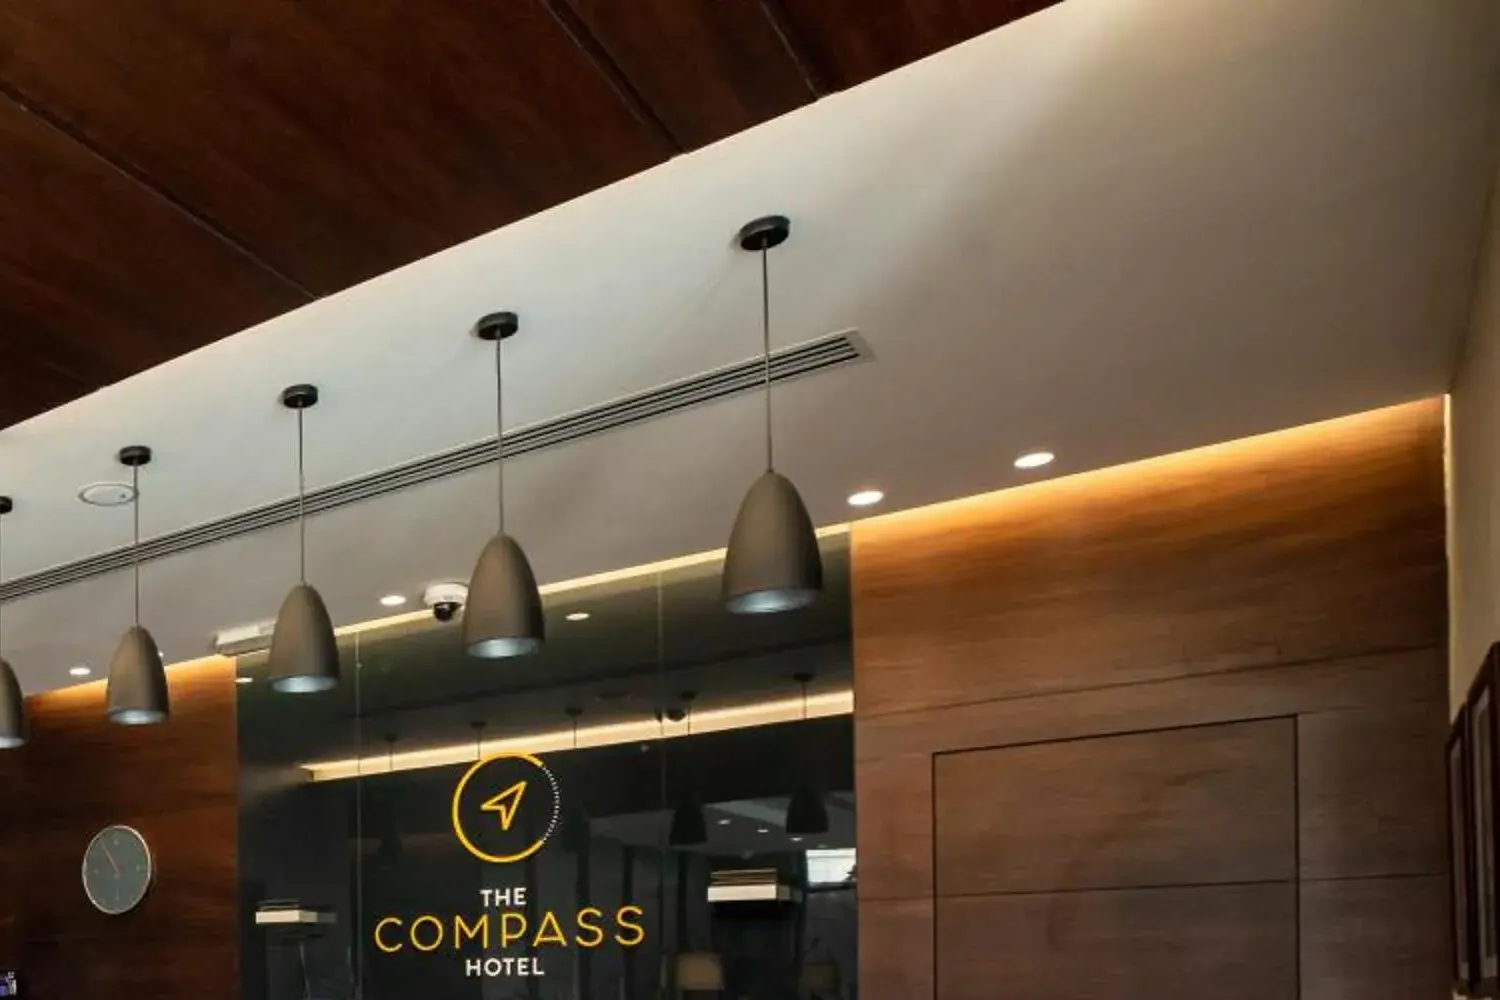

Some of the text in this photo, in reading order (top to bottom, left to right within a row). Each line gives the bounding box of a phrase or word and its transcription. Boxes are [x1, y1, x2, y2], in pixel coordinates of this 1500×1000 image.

[480, 887, 527, 907] THE
[374, 906, 645, 952] COMPASS
[465, 957, 545, 977] HOTEL
